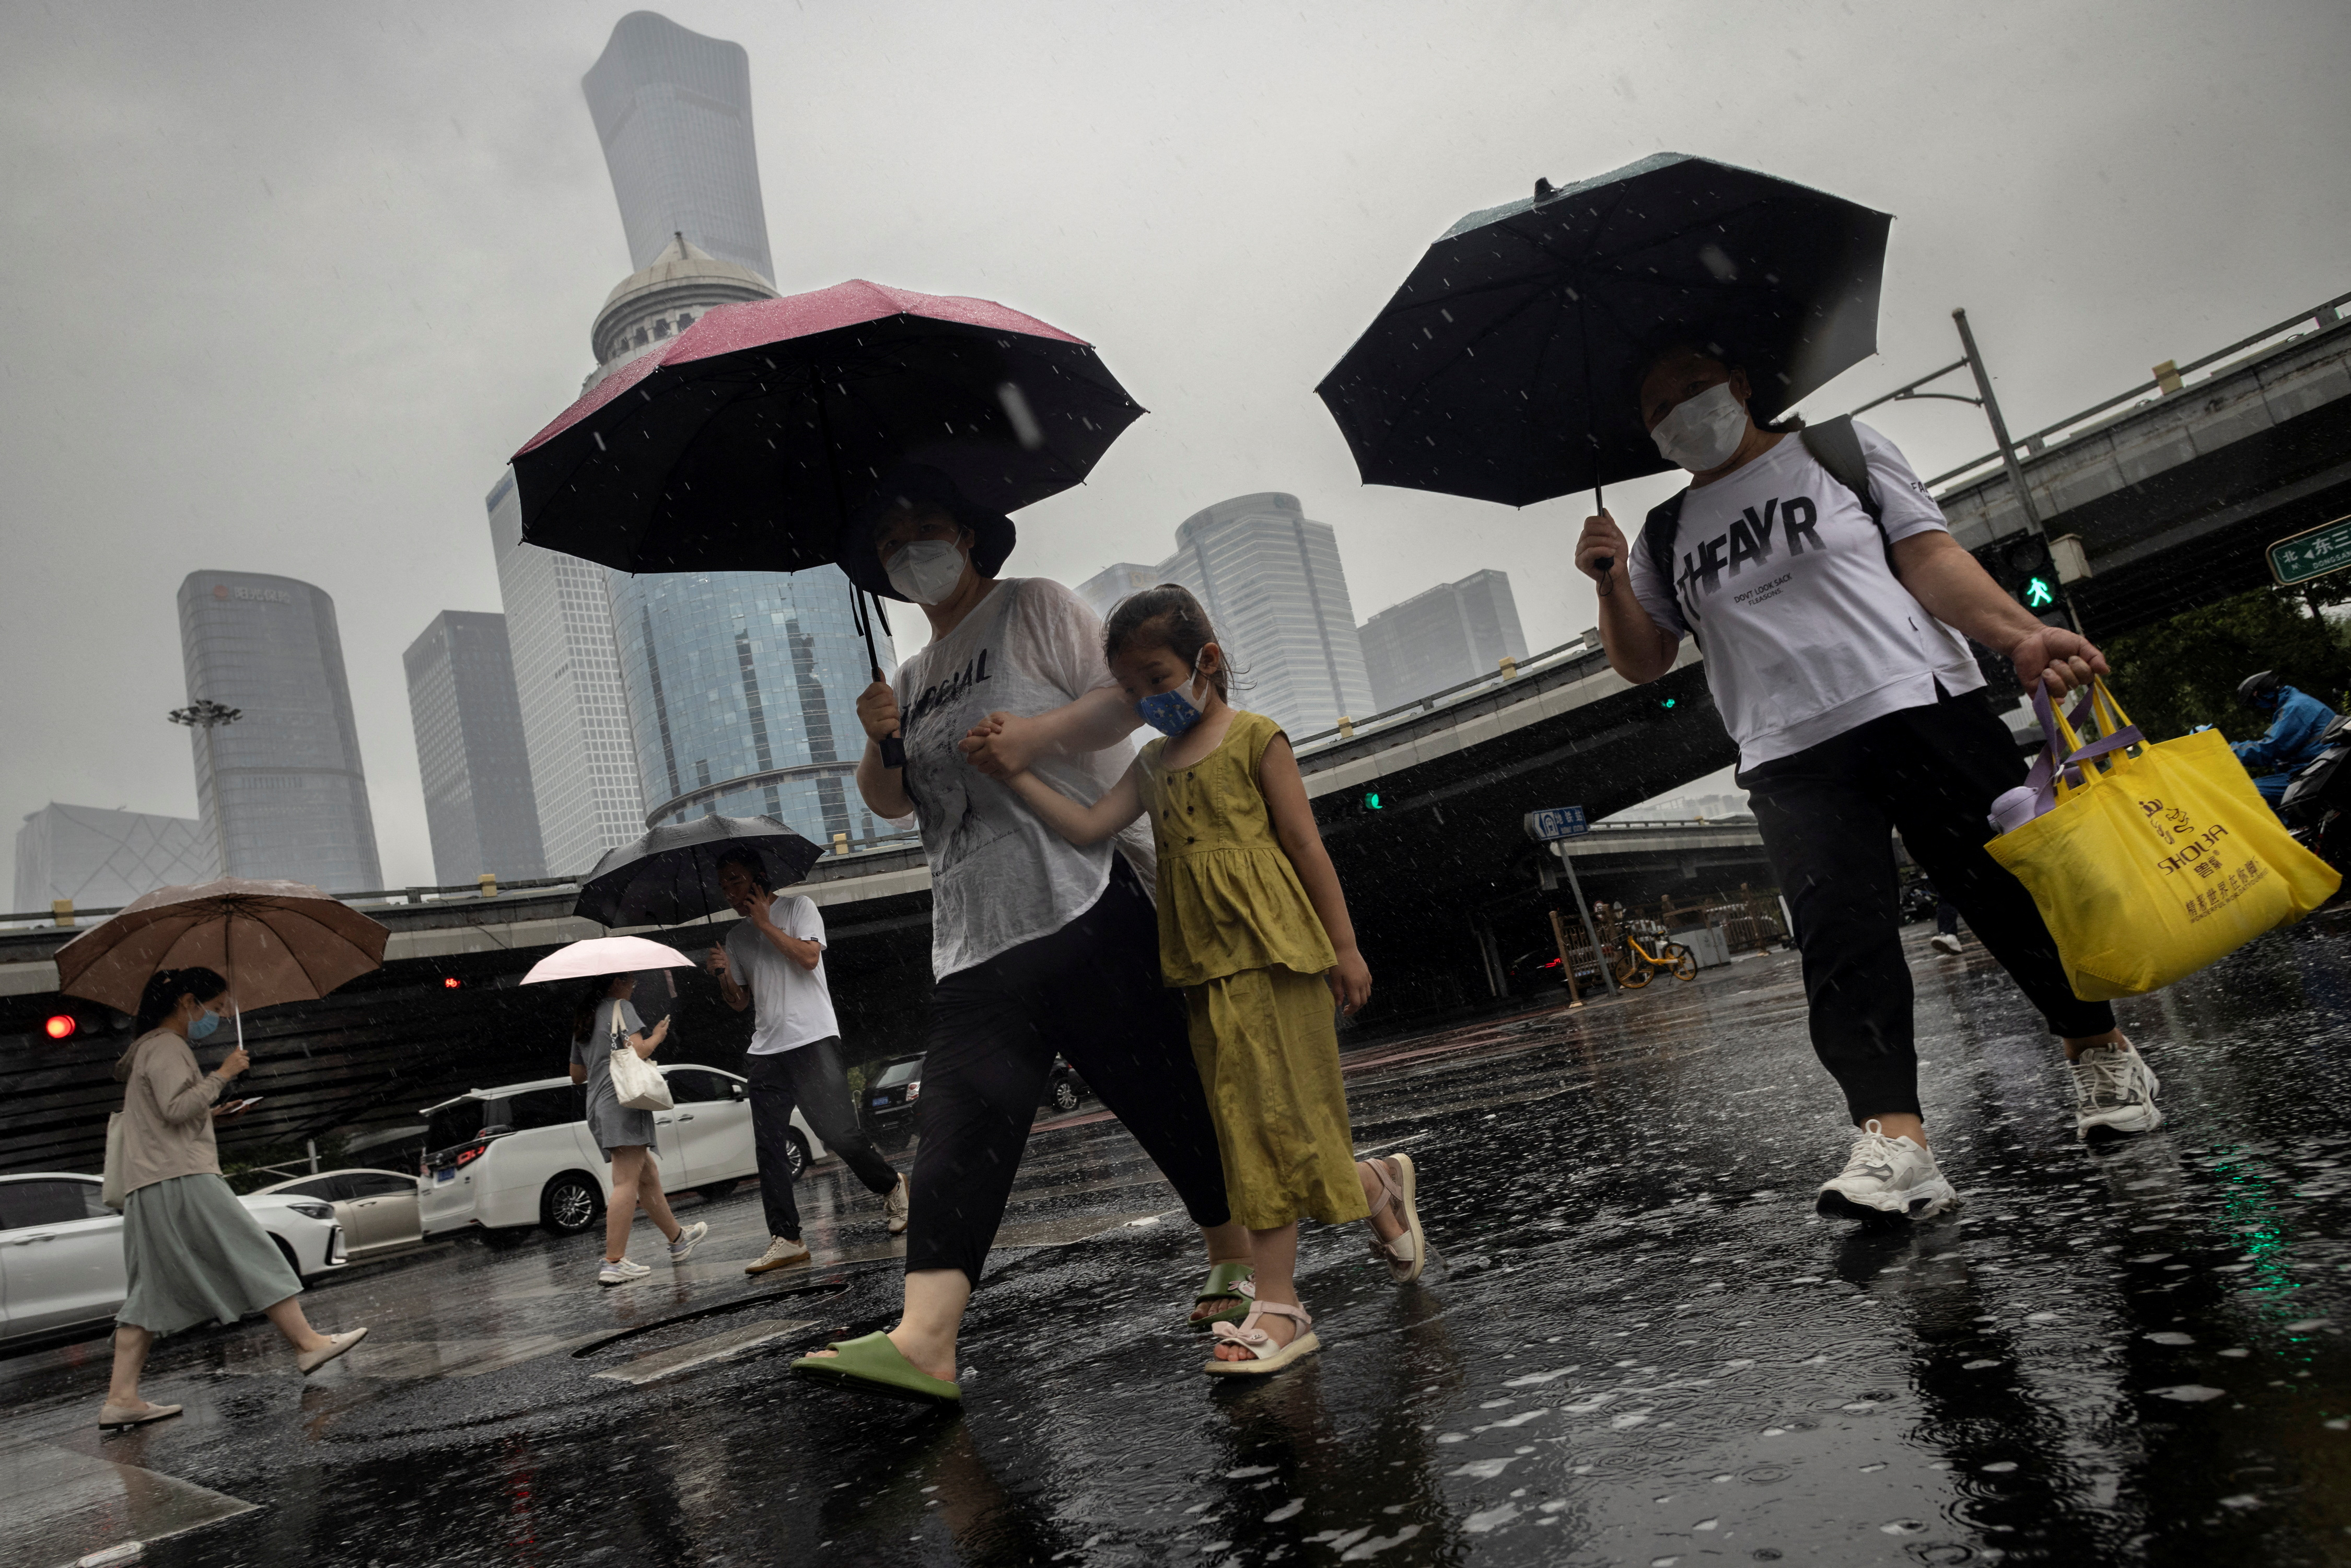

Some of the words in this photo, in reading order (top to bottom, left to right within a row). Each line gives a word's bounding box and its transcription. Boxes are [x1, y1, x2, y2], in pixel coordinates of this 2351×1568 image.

[2311, 527, 2351, 556] 东三
[2283, 550, 2299, 564] 北
[1754, 582, 1774, 595] LOOK
[1774, 573, 1793, 588] SACK
